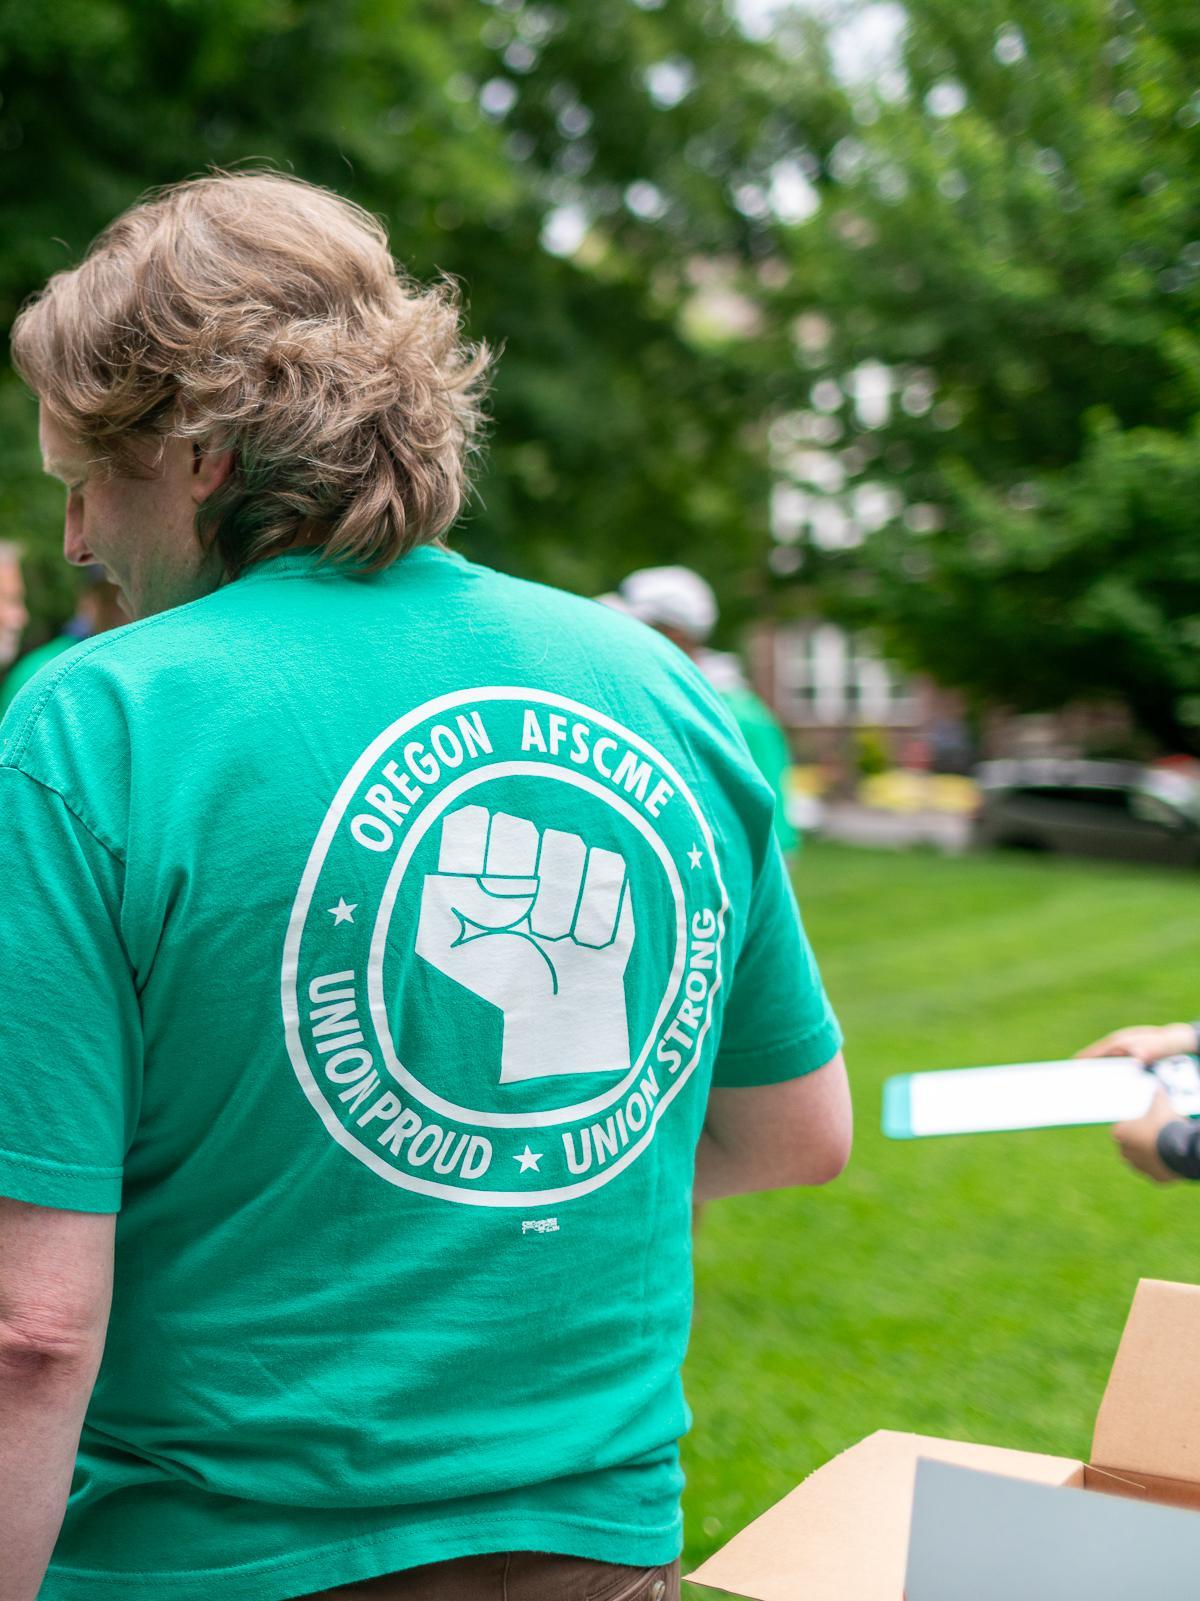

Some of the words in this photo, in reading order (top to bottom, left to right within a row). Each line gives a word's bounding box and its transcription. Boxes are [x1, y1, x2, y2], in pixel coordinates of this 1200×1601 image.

[351, 711, 493, 853] OREGON
[521, 709, 676, 818] AFSCME
[309, 970, 380, 1114] UNION
[356, 1090, 493, 1179] PROUD
[562, 1067, 660, 1174] UNION
[657, 908, 716, 1075] STRONG
